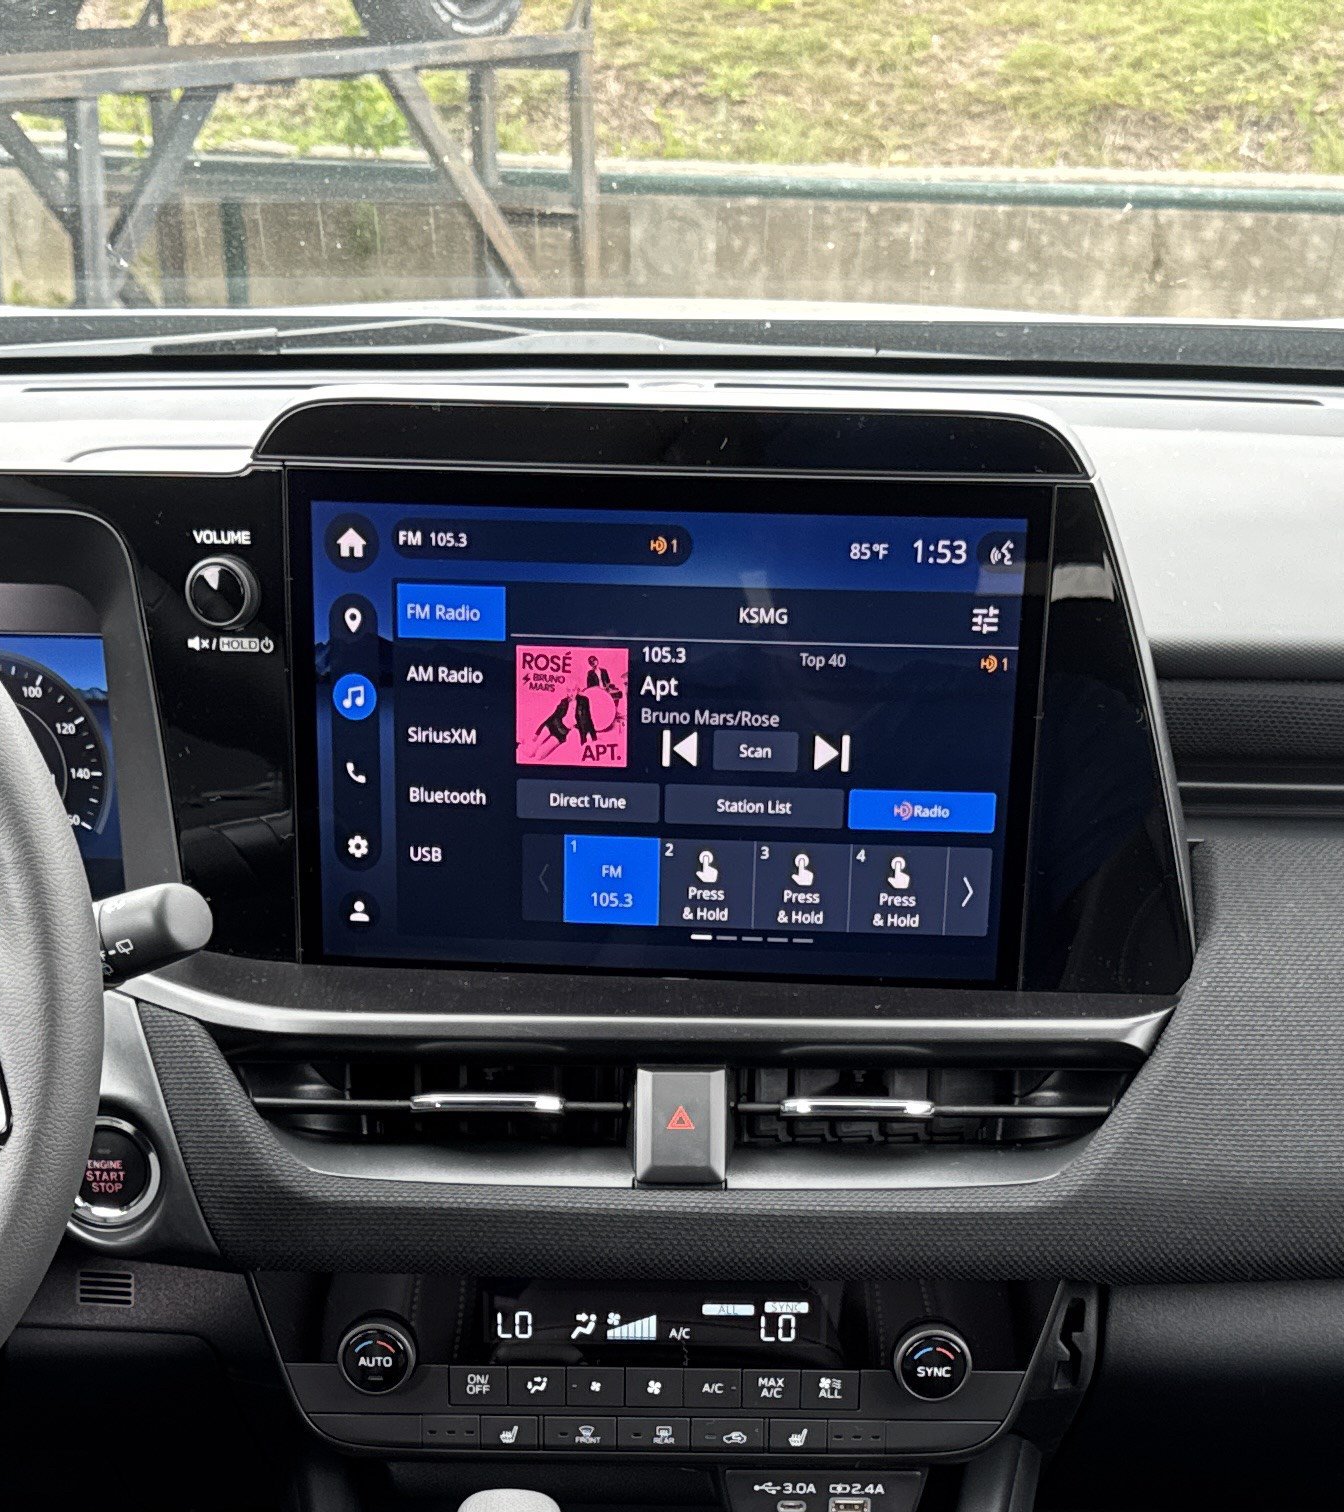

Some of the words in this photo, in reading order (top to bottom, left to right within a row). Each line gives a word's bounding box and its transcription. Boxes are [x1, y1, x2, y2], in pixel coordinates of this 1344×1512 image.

[192, 528, 252, 545] VOLUME
[398, 530, 422, 546] FM
[429, 531, 468, 547] 105.3
[849, 543, 889, 560] 85°F
[913, 539, 967, 565] 1:53
[406, 602, 431, 620] FM
[435, 602, 481, 622] Radio
[738, 607, 789, 625] KSMG
[220, 638, 260, 652] HOLD
[522, 651, 573, 674] ROSÉ
[642, 646, 687, 664] 105.3
[799, 652, 827, 671] Top
[828, 653, 847, 668] 40
[406, 665, 433, 682] AM
[438, 666, 484, 684] Radio
[532, 673, 566, 684] BRUNO
[22, 686, 43, 699] 100
[529, 682, 556, 693] MARS
[640, 674, 679, 701] Apt
[641, 707, 690, 726] Bruno
[694, 709, 780, 728] Mars/Rose
[55, 722, 76, 735] 120
[407, 726, 477, 745] SiriusXM
[581, 743, 622, 762] APT.
[739, 743, 772, 760] Scan
[70, 767, 91, 780] 140
[409, 785, 487, 807] Bluetooth
[549, 792, 590, 808] Direct
[592, 794, 627, 810] Tune
[716, 799, 765, 814] Station
[767, 800, 792, 815] List
[570, 839, 578, 853] 1
[664, 843, 675, 858] 2
[759, 846, 770, 861] 3
[409, 845, 442, 863] USB
[856, 849, 867, 864] 4
[601, 864, 623, 879] FM
[590, 891, 634, 908] 105.3
[688, 886, 725, 901] Press
[783, 889, 820, 904] Press
[879, 892, 916, 907] Press
[681, 907, 694, 921] &
[696, 907, 729, 922] Hold
[776, 910, 789, 924] &
[791, 910, 824, 925] Hold
[872, 913, 885, 927] &
[887, 913, 920, 928] Hold
[87, 1159, 123, 1169] ENGINE
[85, 1170, 126, 1182] START
[91, 1182, 123, 1193] STOP
[718, 1304, 739, 1315] ALL
[771, 1302, 802, 1313] SYNC
[496, 1311, 533, 1339] LO
[760, 1314, 796, 1342] LO
[668, 1327, 691, 1341] A/C
[358, 1356, 393, 1368] AUTO
[467, 1373, 489, 1385] ON/
[916, 1366, 952, 1378] SYNC
[466, 1384, 491, 1395] OFF
[702, 1383, 725, 1394] A/C
[758, 1377, 785, 1388] MAX
[760, 1388, 783, 1399] A/C
[818, 1388, 842, 1399] ALL
[575, 1435, 602, 1444] FRONT
[782, 1483, 817, 1494] 3.0A
[851, 1484, 886, 1495] 2.4A
